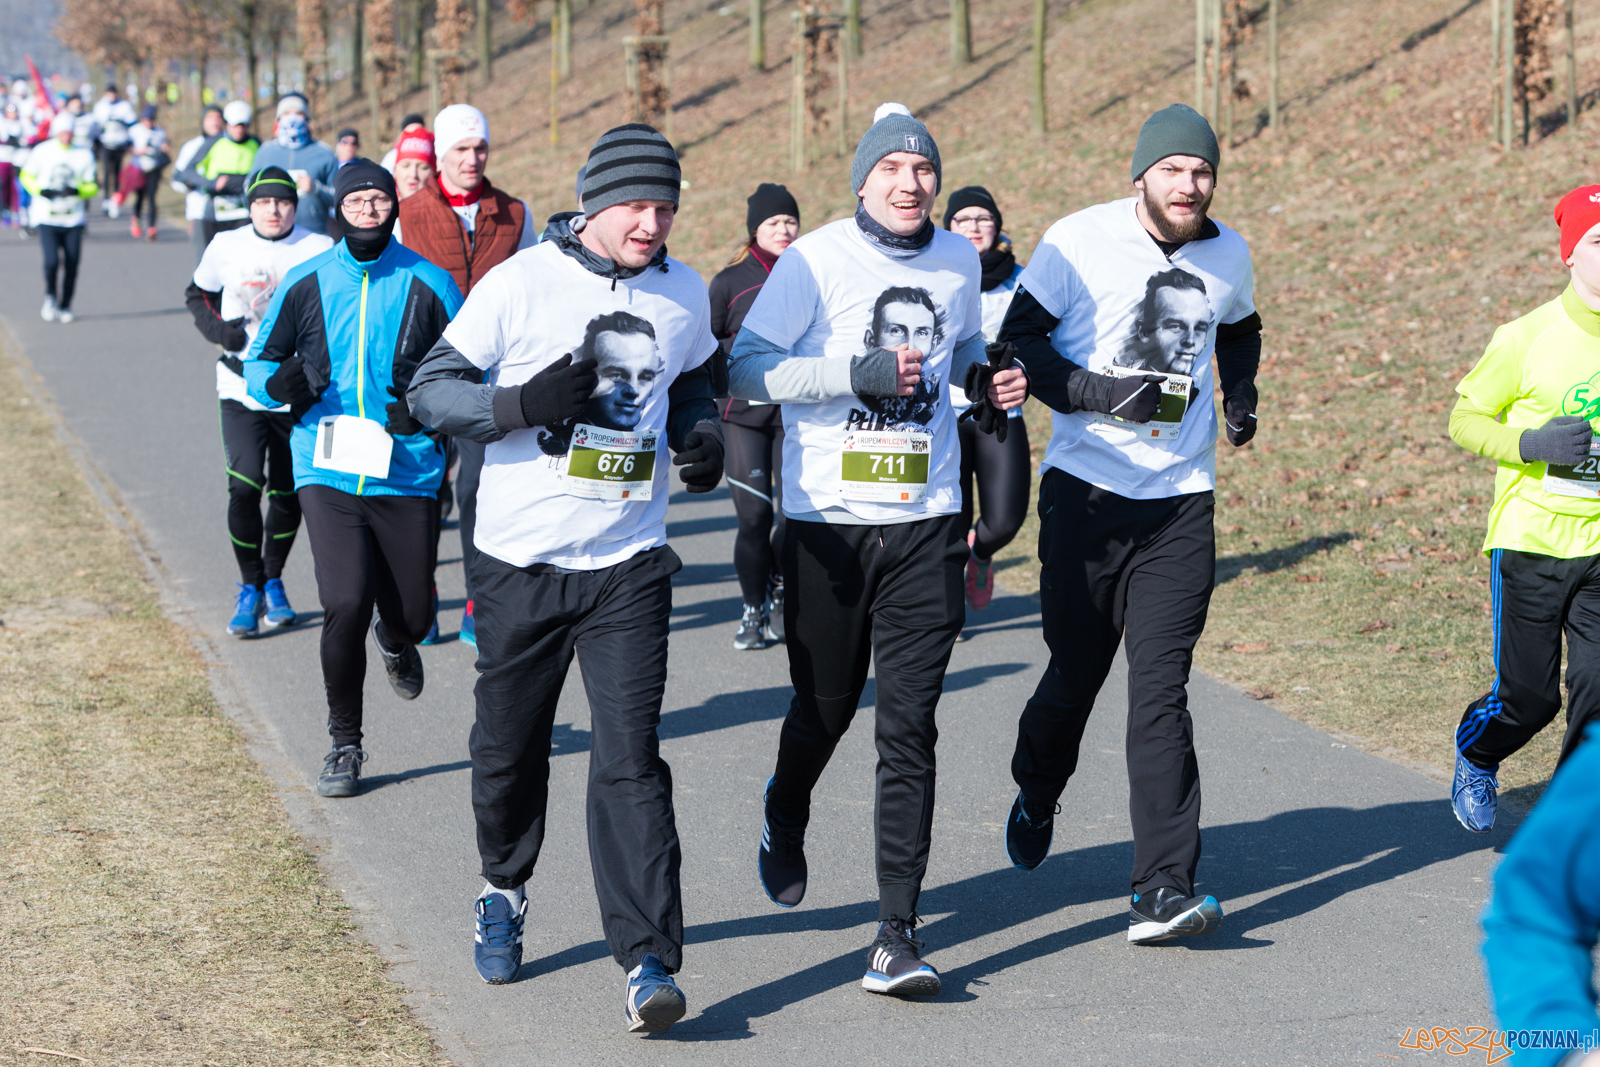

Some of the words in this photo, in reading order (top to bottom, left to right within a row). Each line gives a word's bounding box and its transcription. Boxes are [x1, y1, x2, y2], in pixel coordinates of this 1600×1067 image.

[591, 432, 639, 445] TROPEMWILCZYM
[858, 436, 907, 446] TROPEMWILCZYM
[597, 453, 635, 474] 676
[870, 455, 905, 475] 711
